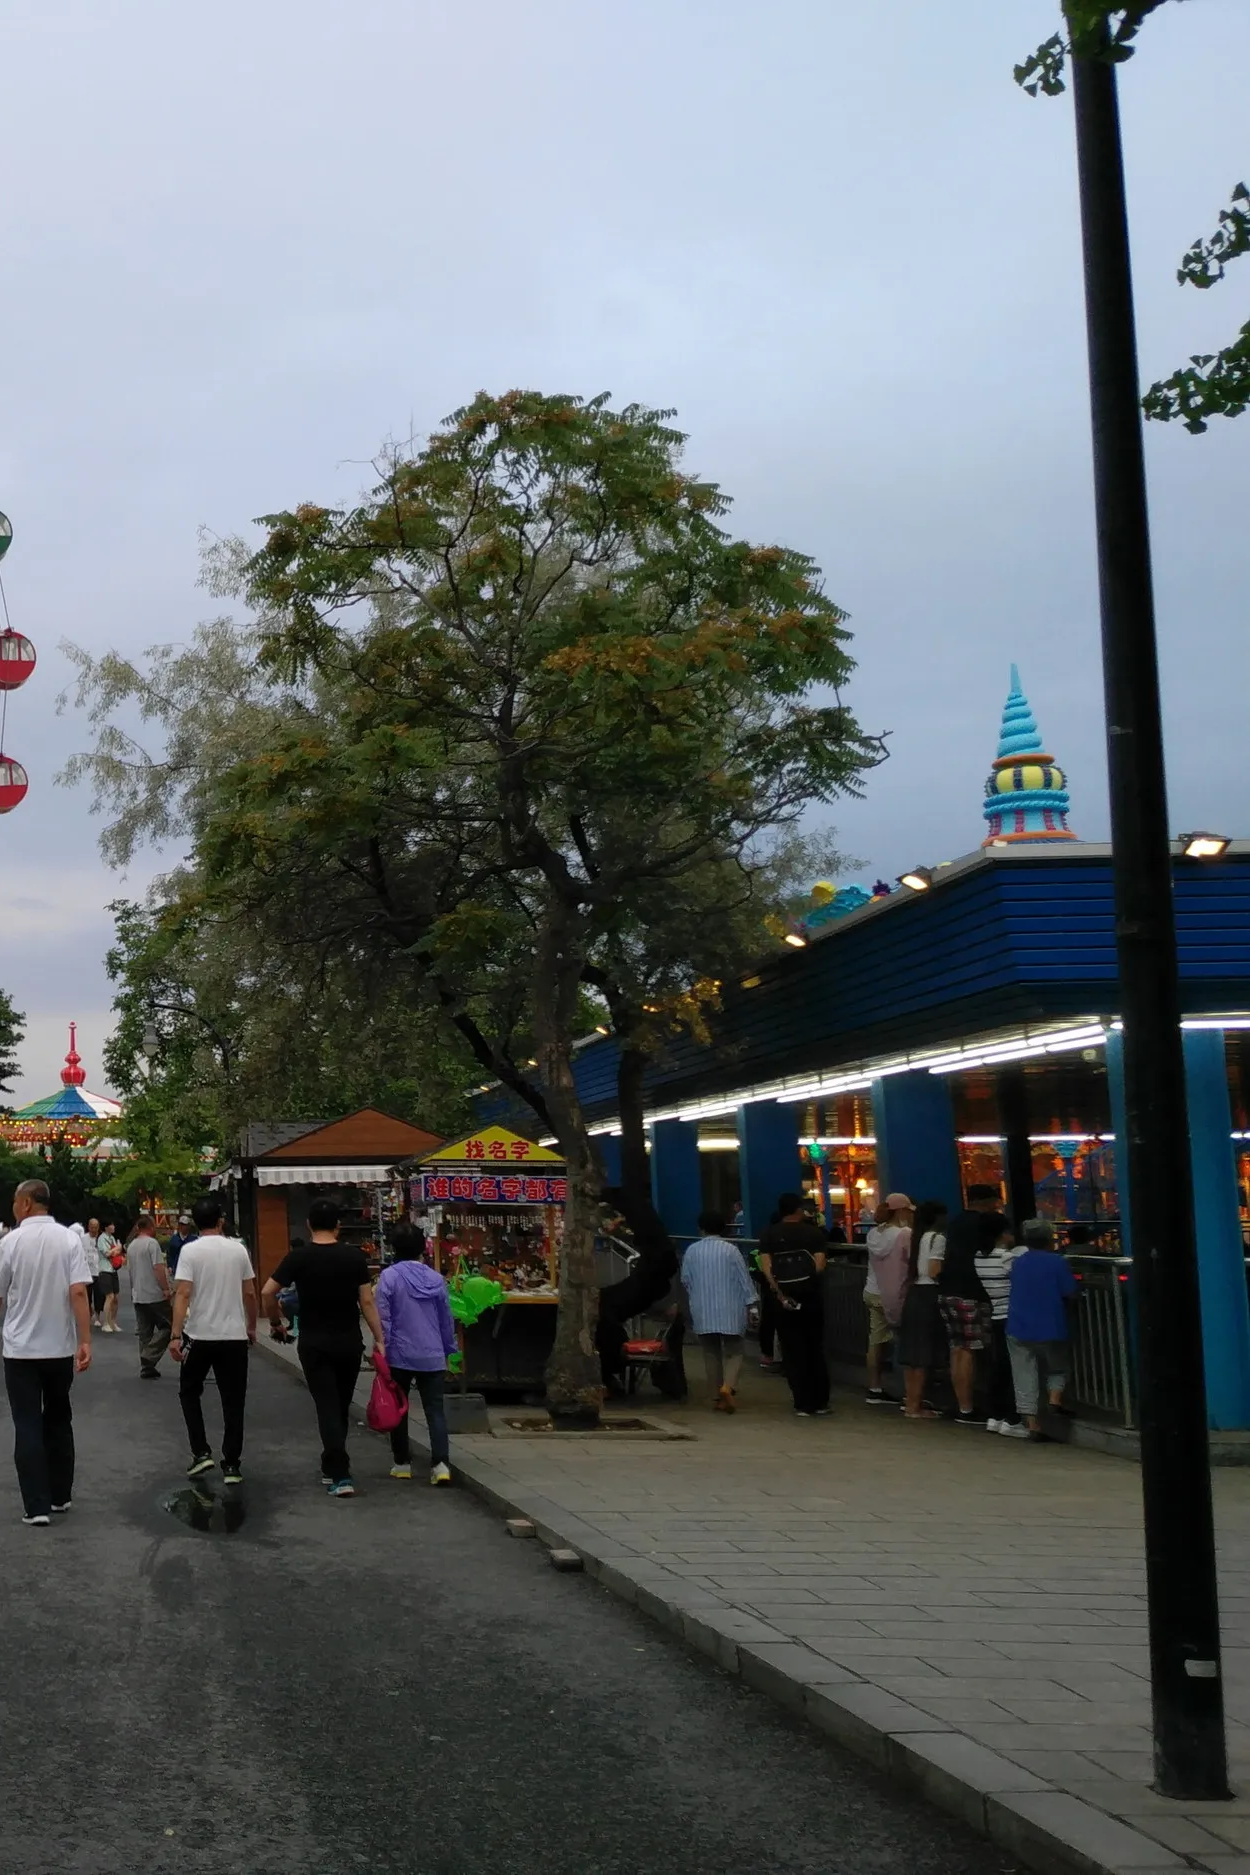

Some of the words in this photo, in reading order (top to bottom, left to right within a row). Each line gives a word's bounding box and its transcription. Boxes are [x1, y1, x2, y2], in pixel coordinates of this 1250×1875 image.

[465, 1140, 530, 1160] 找名字
[426, 1176, 567, 1201] 谁的名字都有
